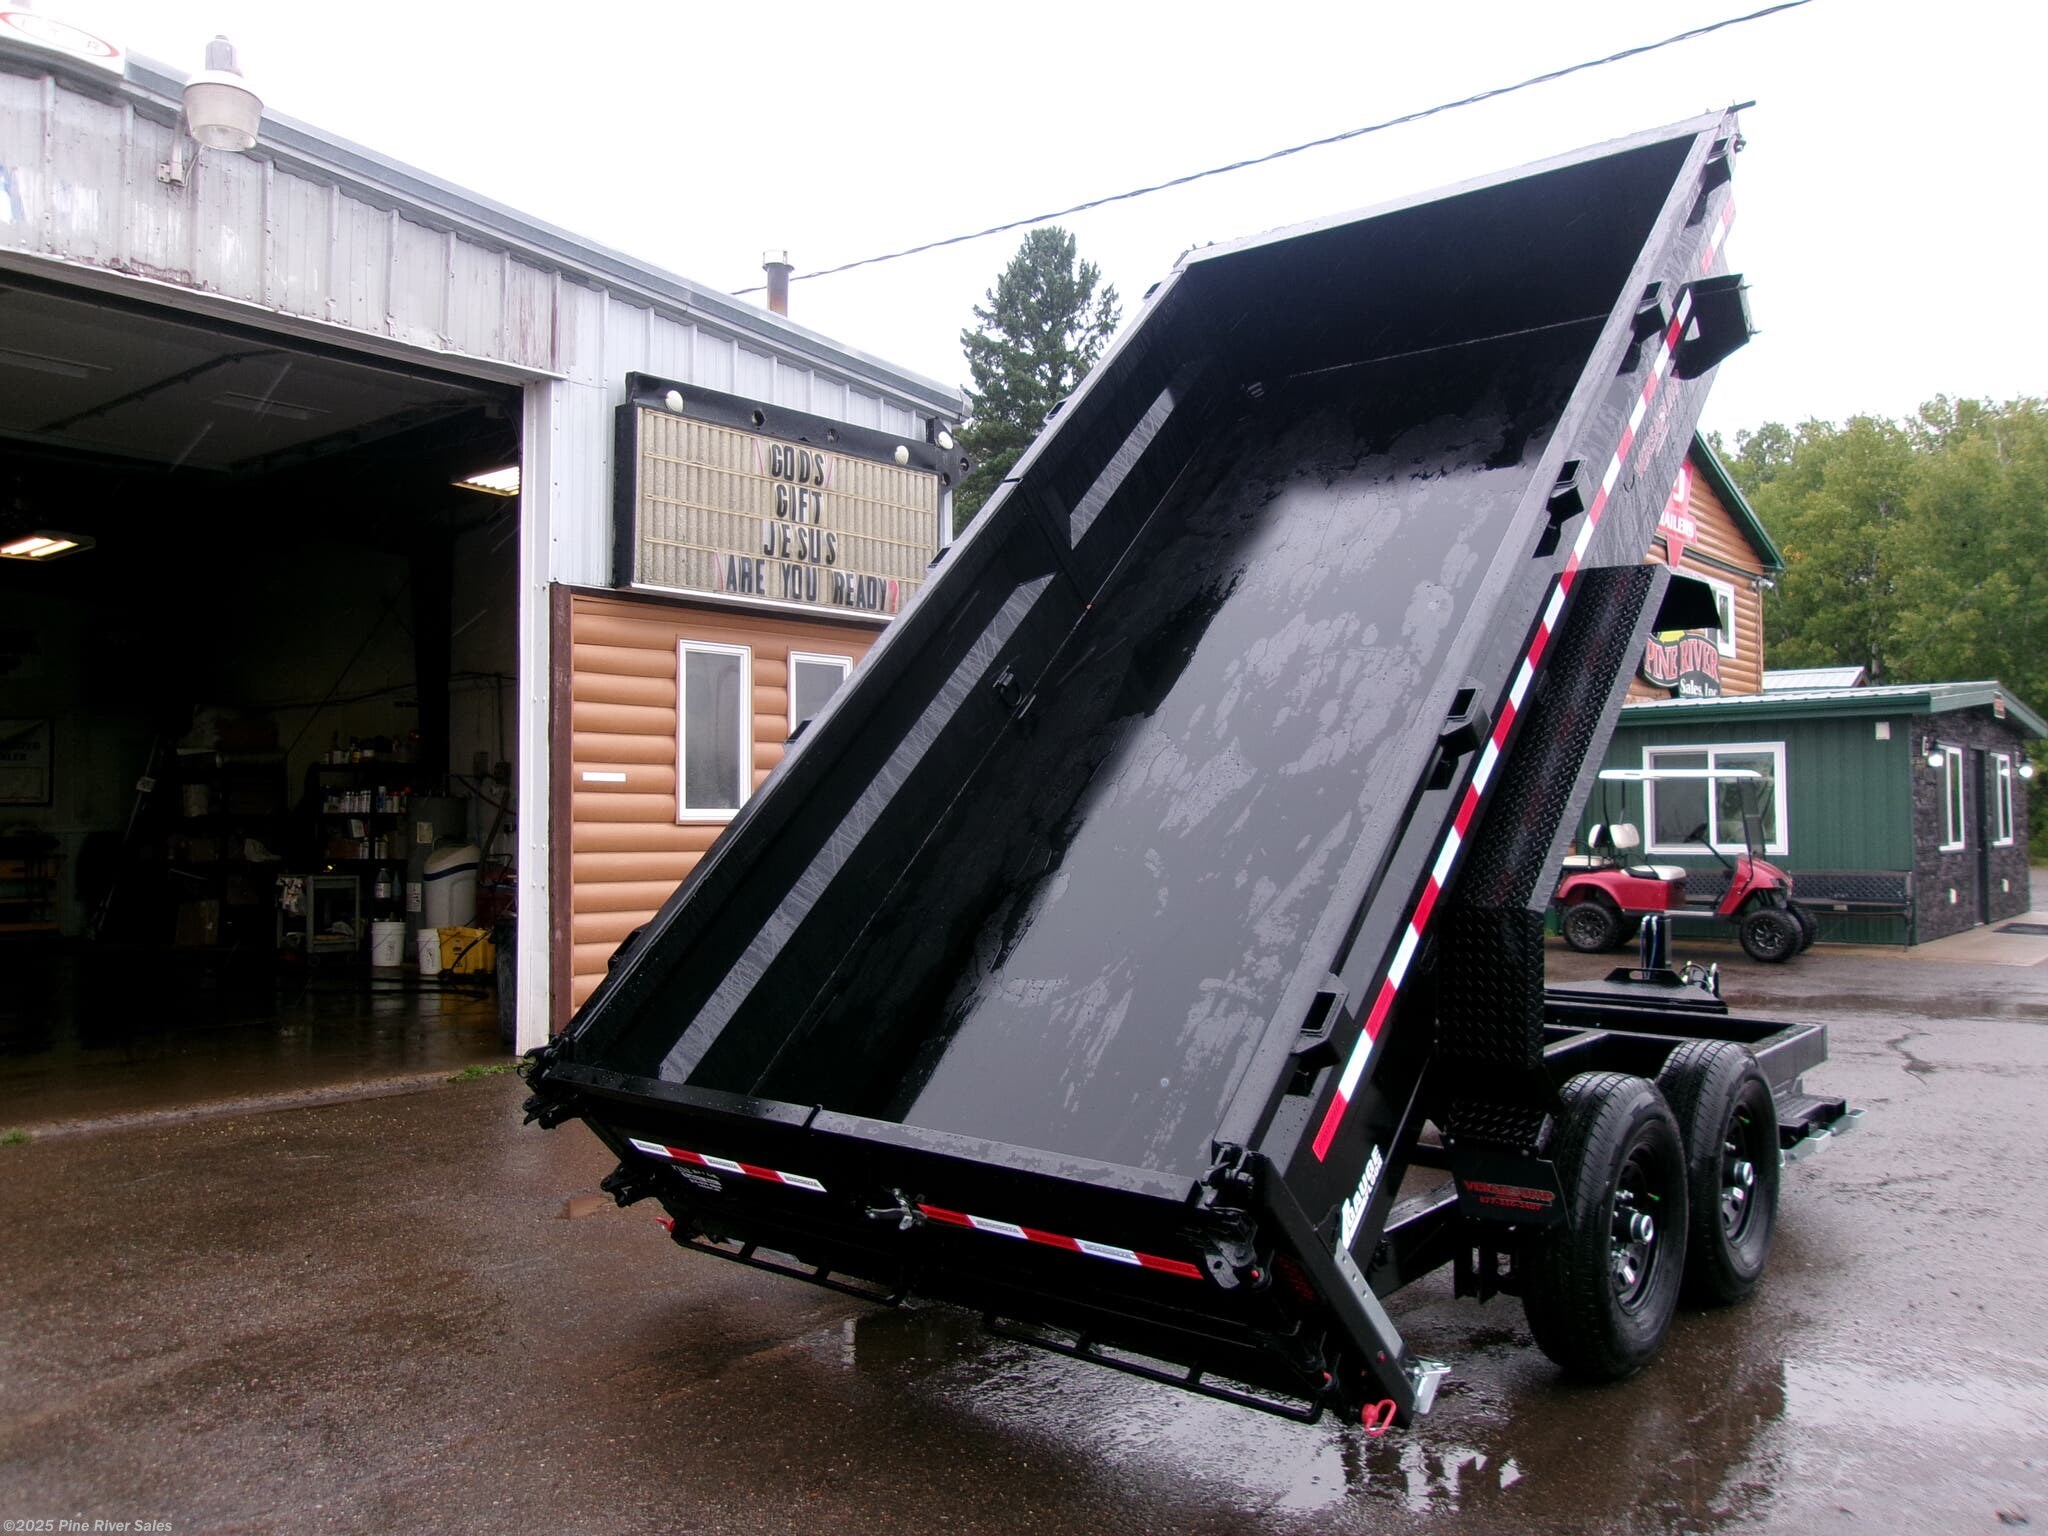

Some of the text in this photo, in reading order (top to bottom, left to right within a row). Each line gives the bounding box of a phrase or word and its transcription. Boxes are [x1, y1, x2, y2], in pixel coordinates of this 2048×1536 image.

[771, 443, 825, 485] GODS
[776, 484, 823, 524] GIFT
[764, 522, 837, 565] JESUS
[726, 554, 765, 595] ARE
[781, 564, 817, 601] YOU
[1645, 637, 1720, 684] PINE RIVER
